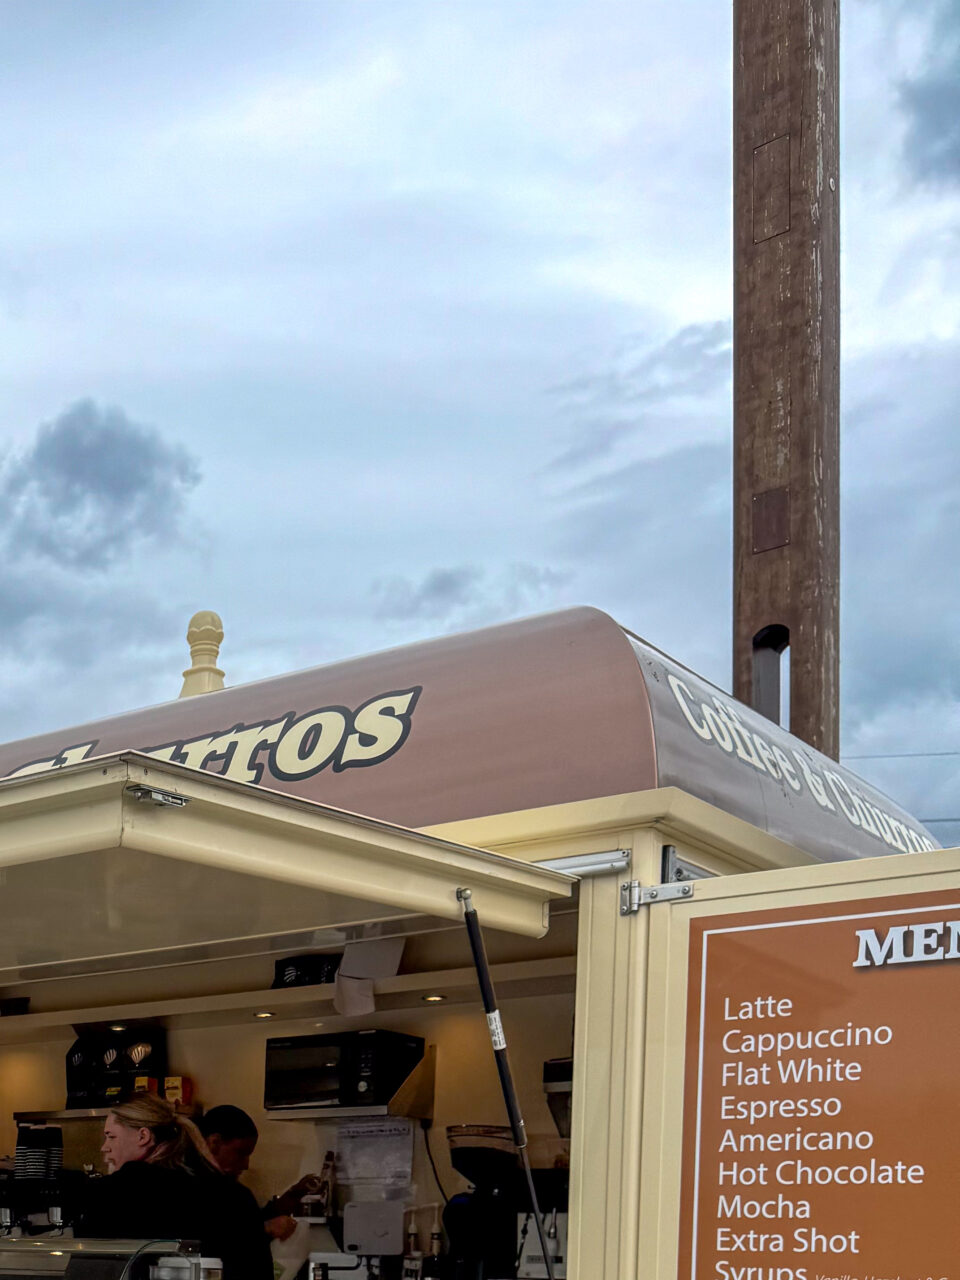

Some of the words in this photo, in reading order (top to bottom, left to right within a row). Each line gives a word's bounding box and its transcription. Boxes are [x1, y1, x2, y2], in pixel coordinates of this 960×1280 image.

[667, 674, 801, 791] Coffee
[793, 750, 836, 811] &
[723, 996, 793, 1021] Latte
[722, 1023, 893, 1057] Cappuccino
[721, 1060, 770, 1087] Flat
[778, 1056, 862, 1083] White
[720, 1095, 842, 1124] Espresso
[718, 1128, 874, 1153] Americano
[718, 1162, 768, 1186] Hot
[775, 1159, 925, 1185] Chocolate
[717, 1195, 811, 1220] Mocha
[716, 1228, 784, 1253] Extra
[793, 1228, 860, 1254] Shot
